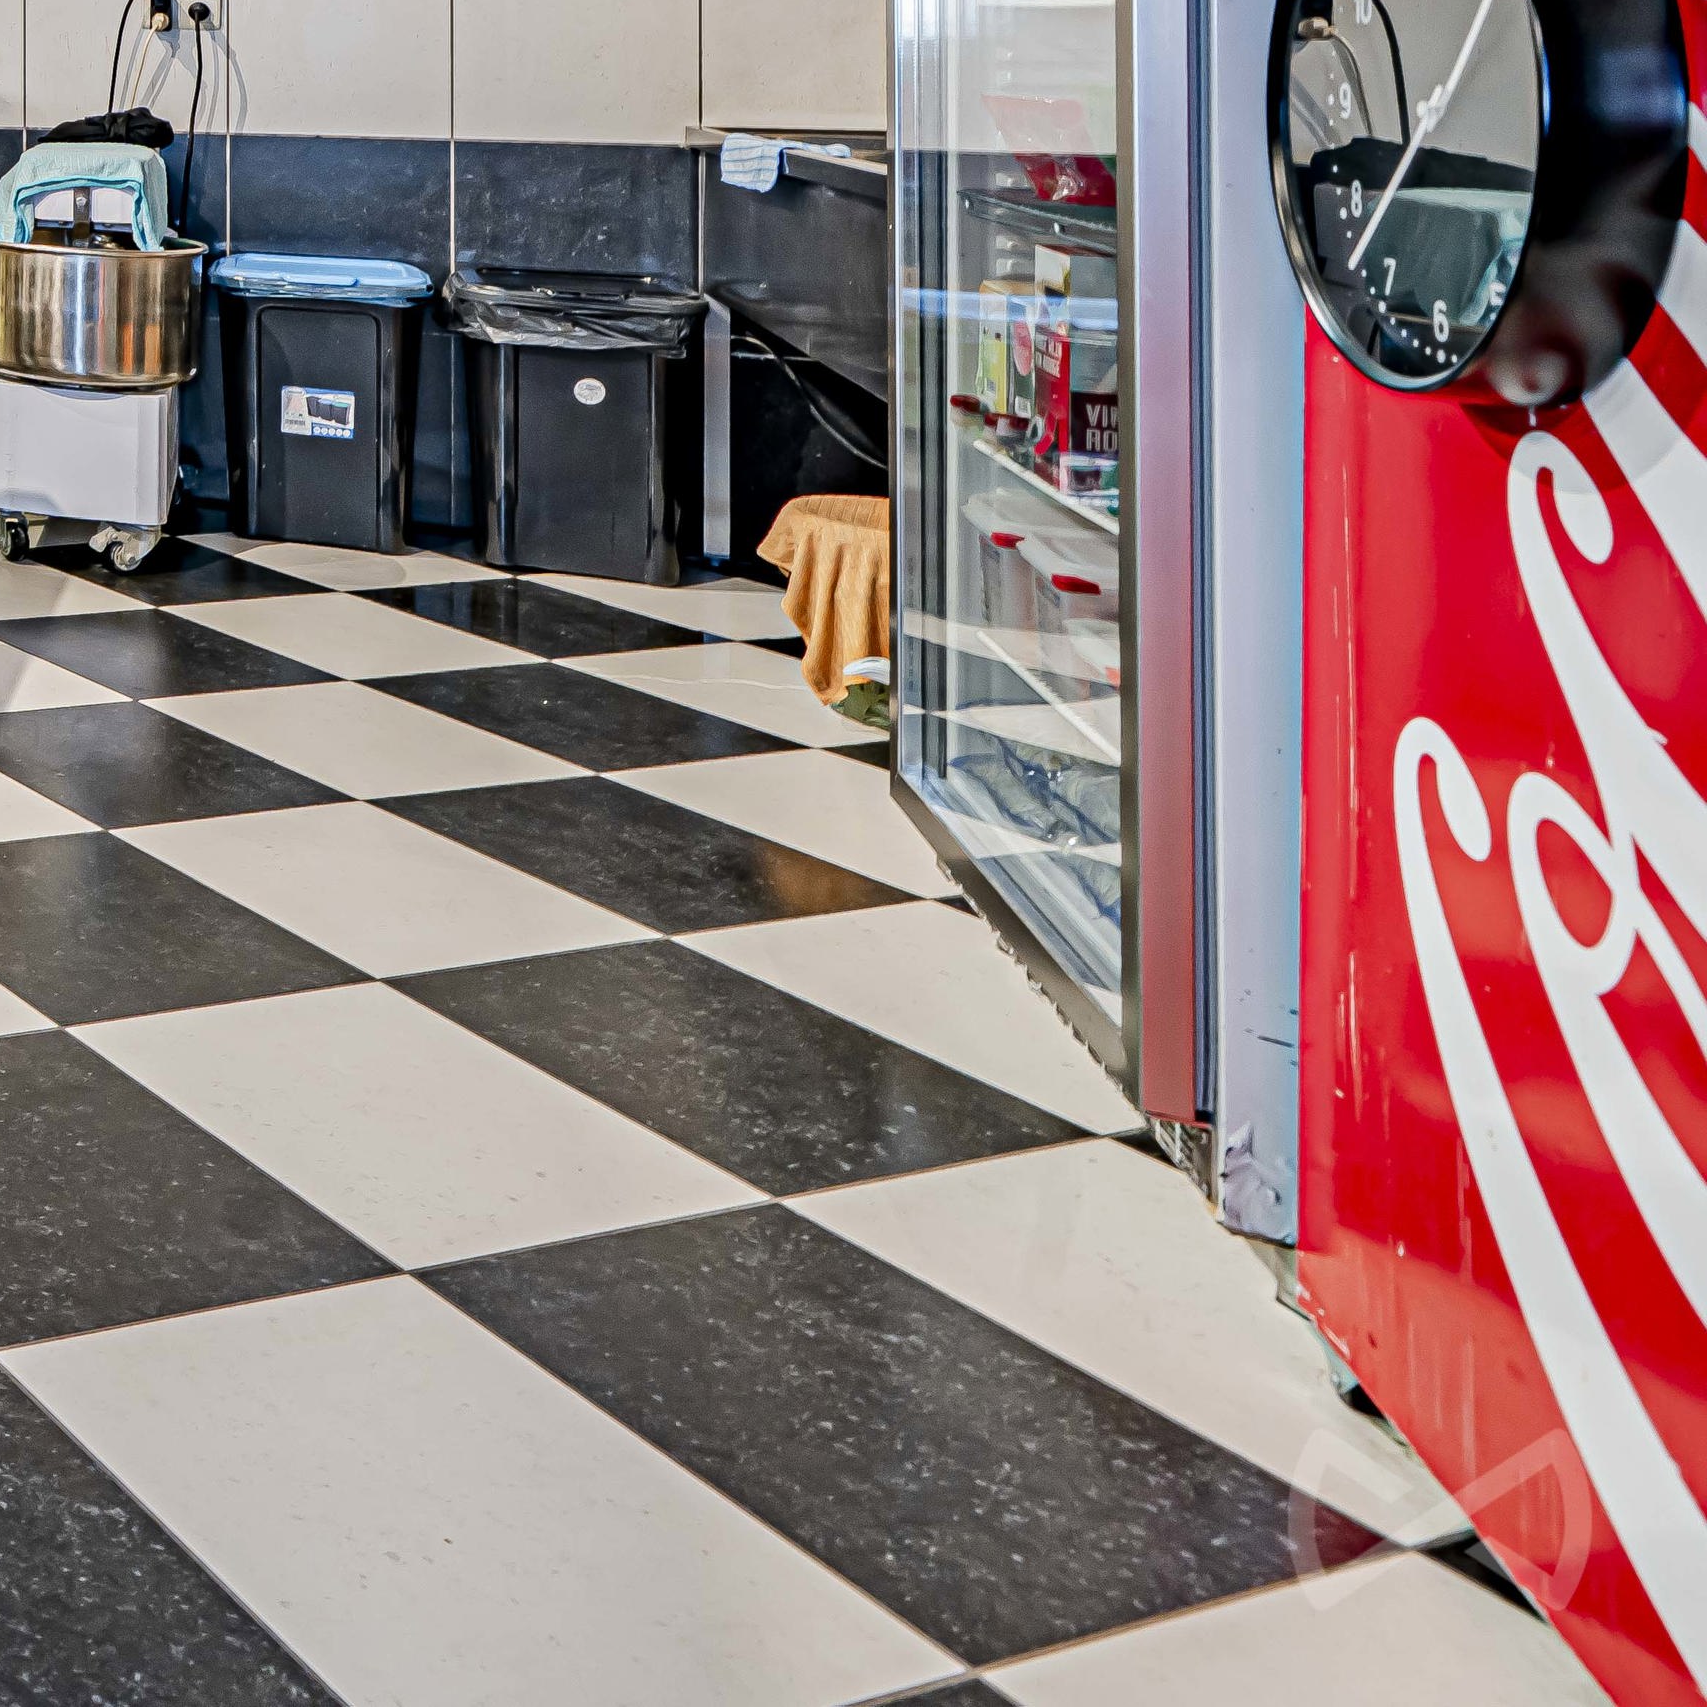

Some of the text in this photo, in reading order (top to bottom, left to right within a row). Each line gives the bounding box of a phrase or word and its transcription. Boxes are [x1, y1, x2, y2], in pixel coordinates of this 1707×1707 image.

[1339, 82, 1353, 120] 9
[1351, 180, 1363, 216] 8
[1383, 258, 1398, 295] 7
[1433, 300, 1449, 342] 6
